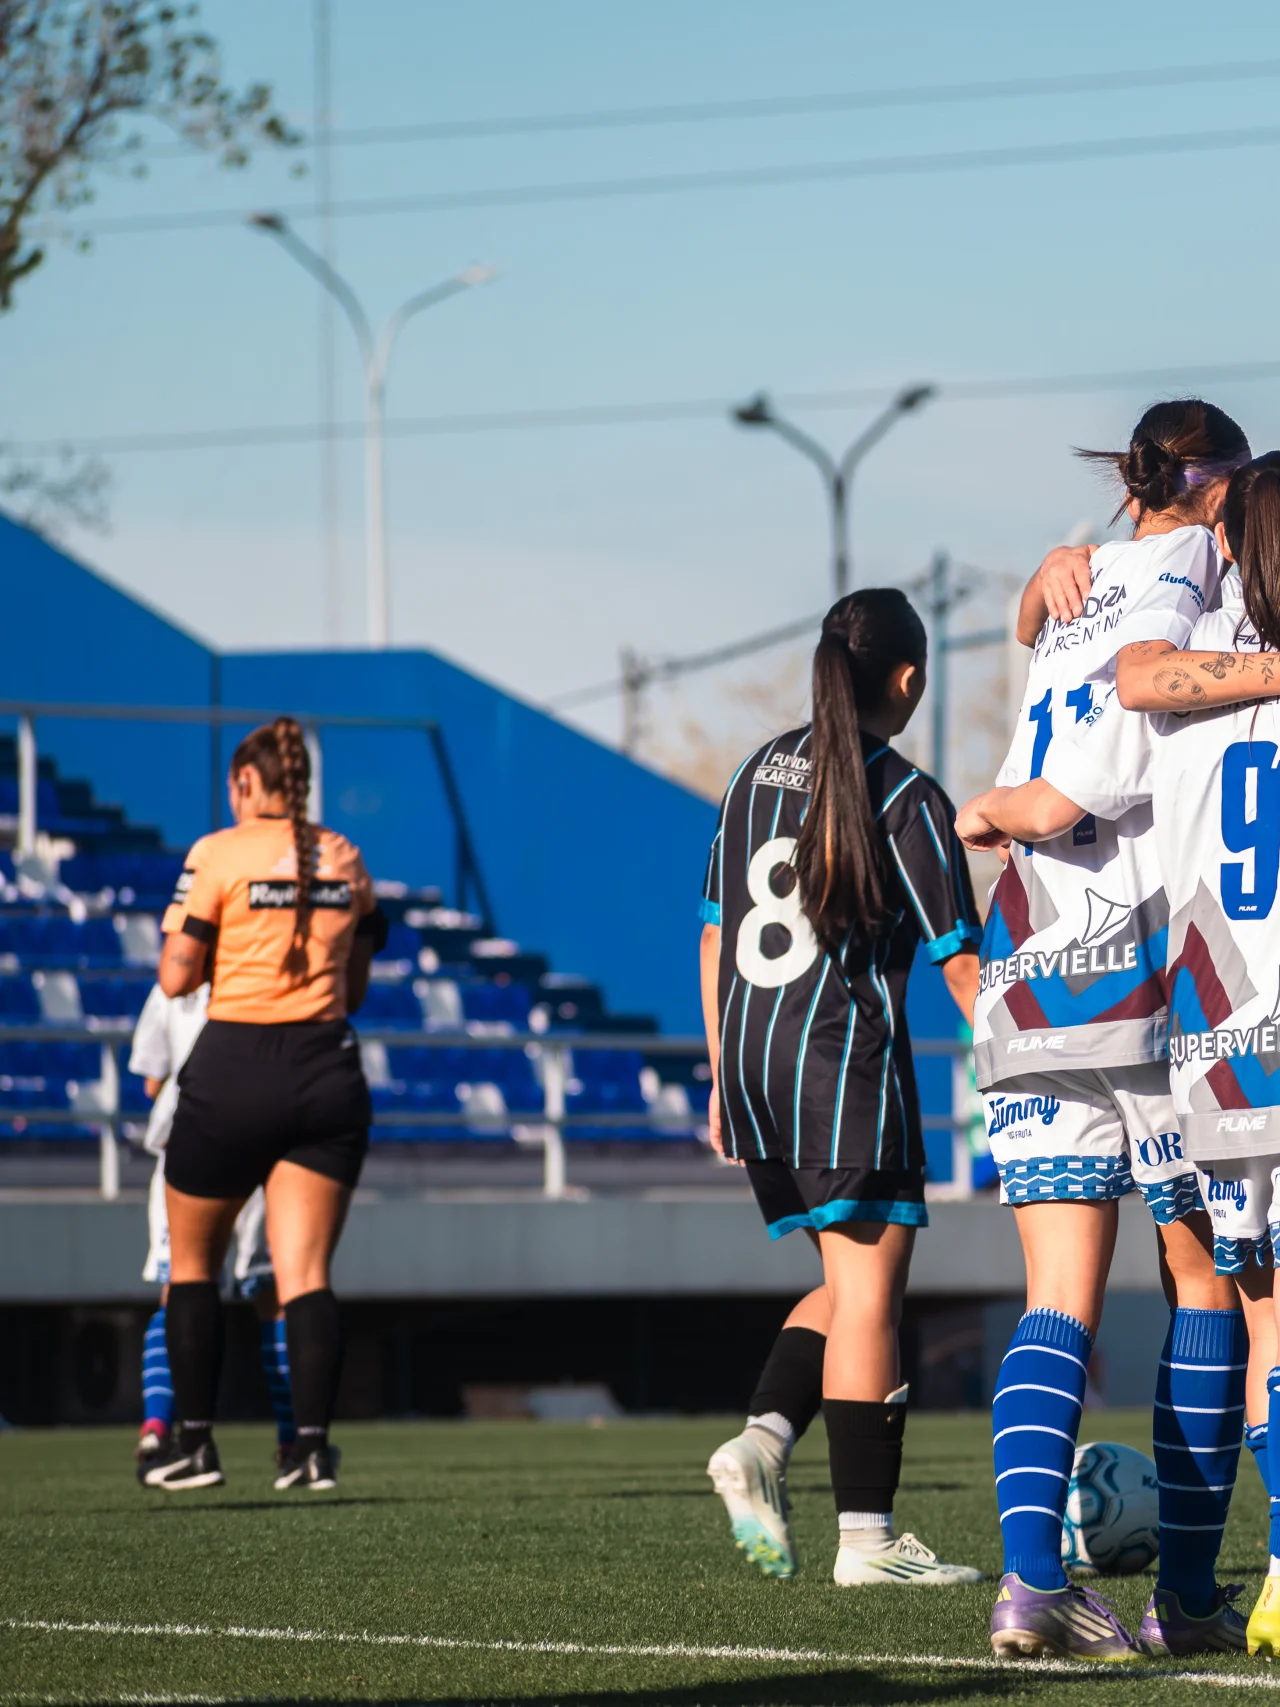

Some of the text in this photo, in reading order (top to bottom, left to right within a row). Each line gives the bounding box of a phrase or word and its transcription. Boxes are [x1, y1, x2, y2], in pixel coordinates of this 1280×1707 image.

[753, 769, 804, 787] RICARDO
[735, 838, 818, 988] 8
[1007, 1035, 1067, 1054] FIUME
[1216, 1115, 1267, 1132] FIUME
